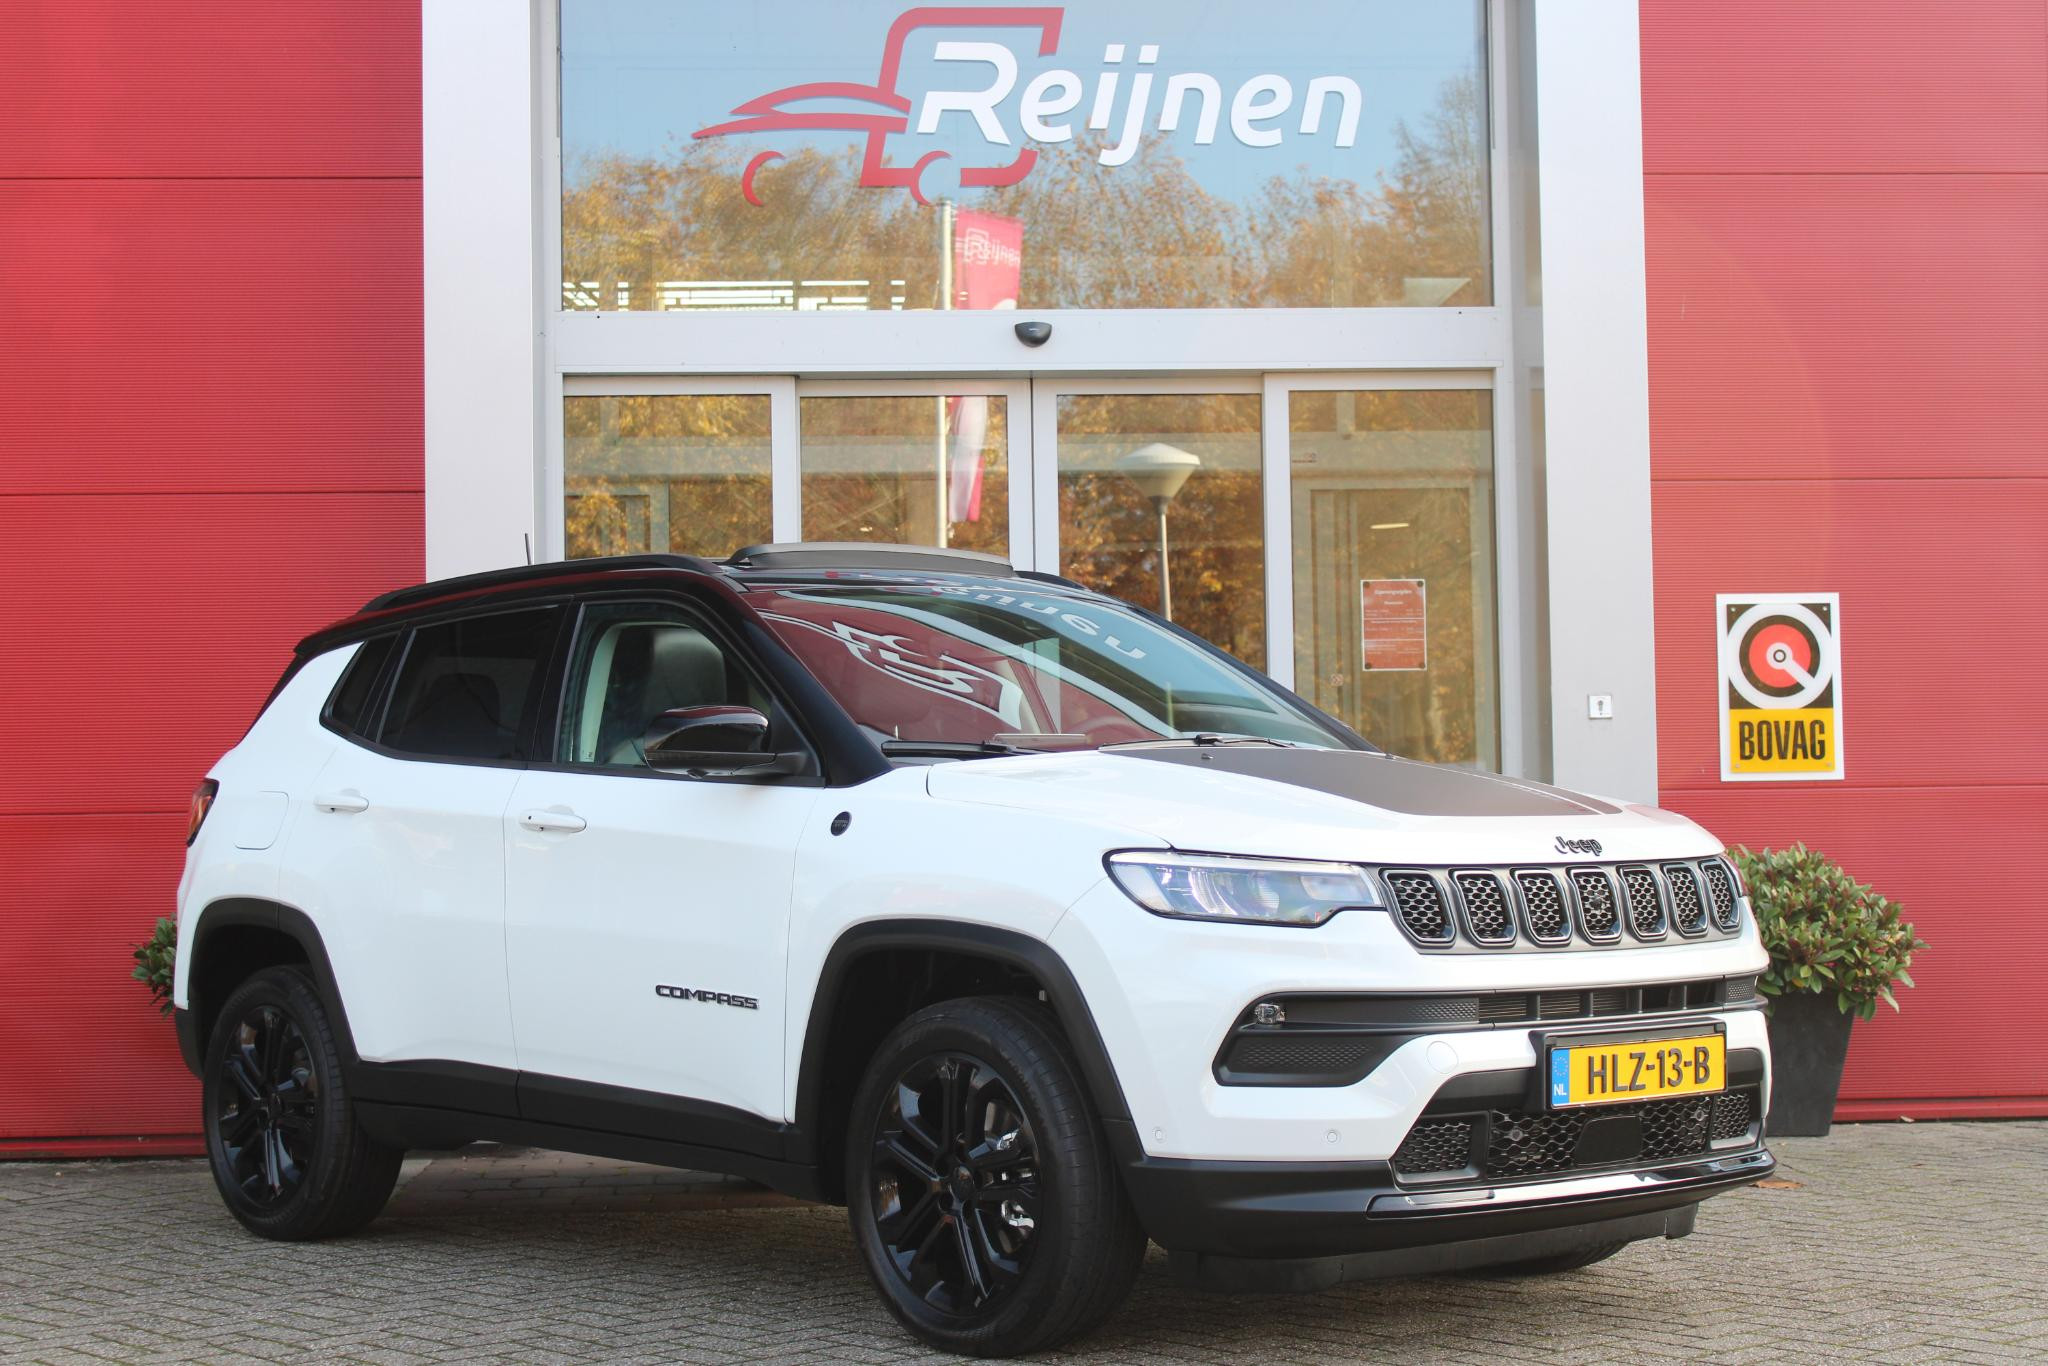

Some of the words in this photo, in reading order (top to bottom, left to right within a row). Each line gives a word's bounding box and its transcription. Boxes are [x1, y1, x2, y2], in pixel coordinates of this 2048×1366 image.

[917, 41, 1362, 166] Reijnen
[1738, 719, 1826, 761] BOVAG
[1554, 836, 1602, 856] Jeep
[655, 984, 758, 1009] COMPASS
[1588, 1046, 1710, 1094] HLZ-13-B
[1553, 1083, 1567, 1096] NL
